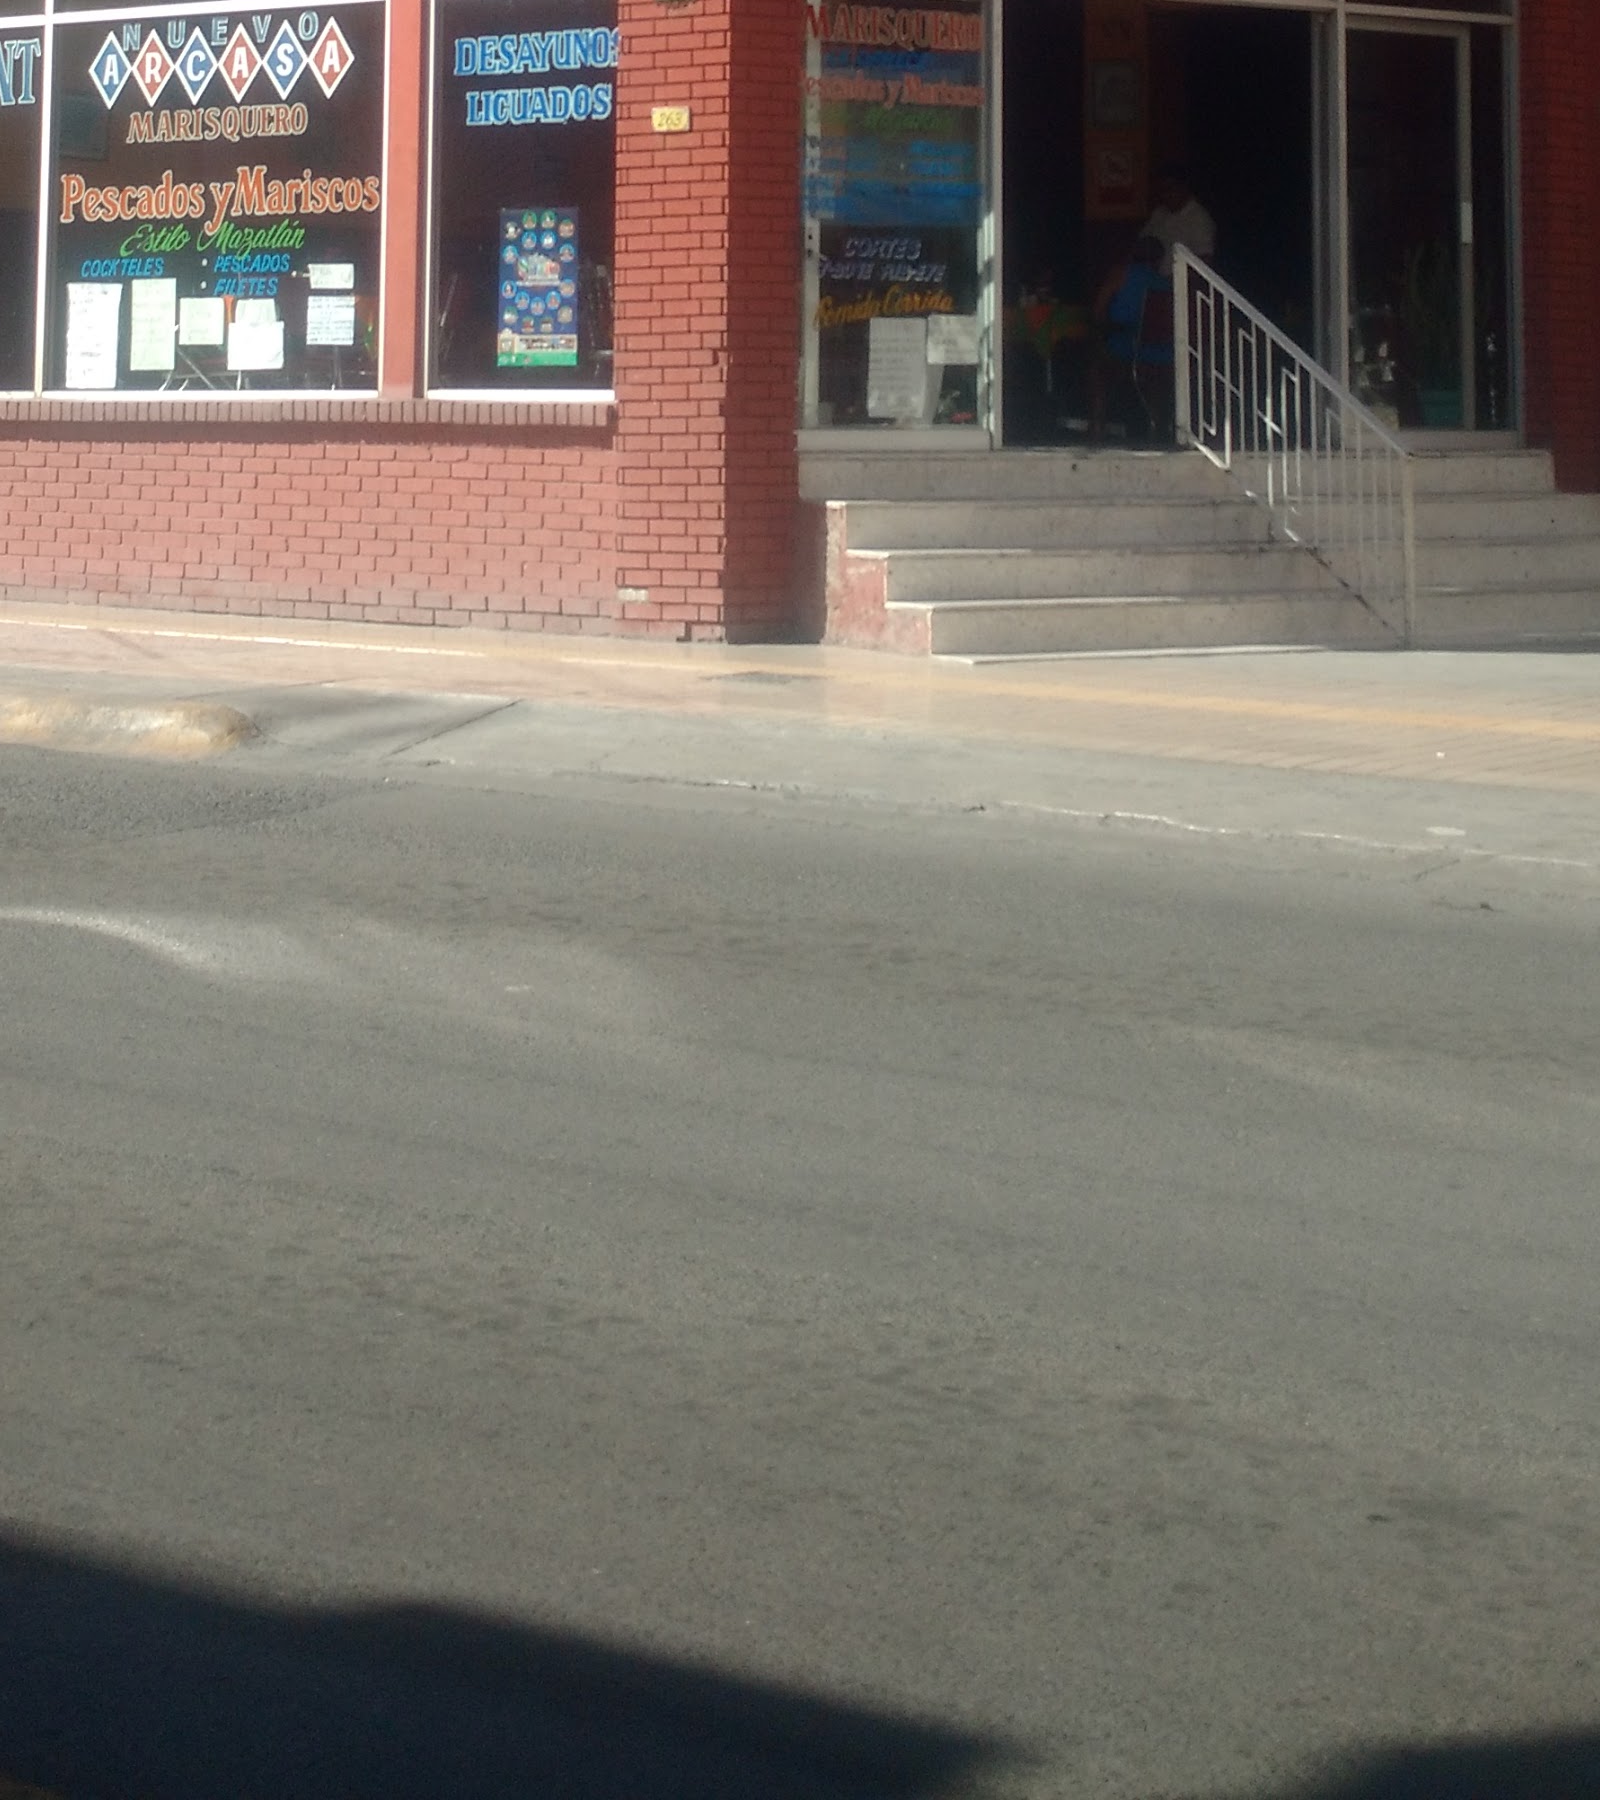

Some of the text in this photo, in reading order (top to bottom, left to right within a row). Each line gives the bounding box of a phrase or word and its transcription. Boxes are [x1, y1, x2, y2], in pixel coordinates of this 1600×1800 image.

[122, 10, 319, 52] NUEVO
[126, 102, 309, 145] MARISQUERO
[466, 82, 613, 126] LICUADOS
[60, 165, 381, 236] Pescados y Mariscos
[120, 219, 305, 260] Estilo Mazatlán
[80, 257, 165, 279] COCKTELES
[213, 253, 291, 273] PESCADOS
[212, 277, 279, 297] FILETES
